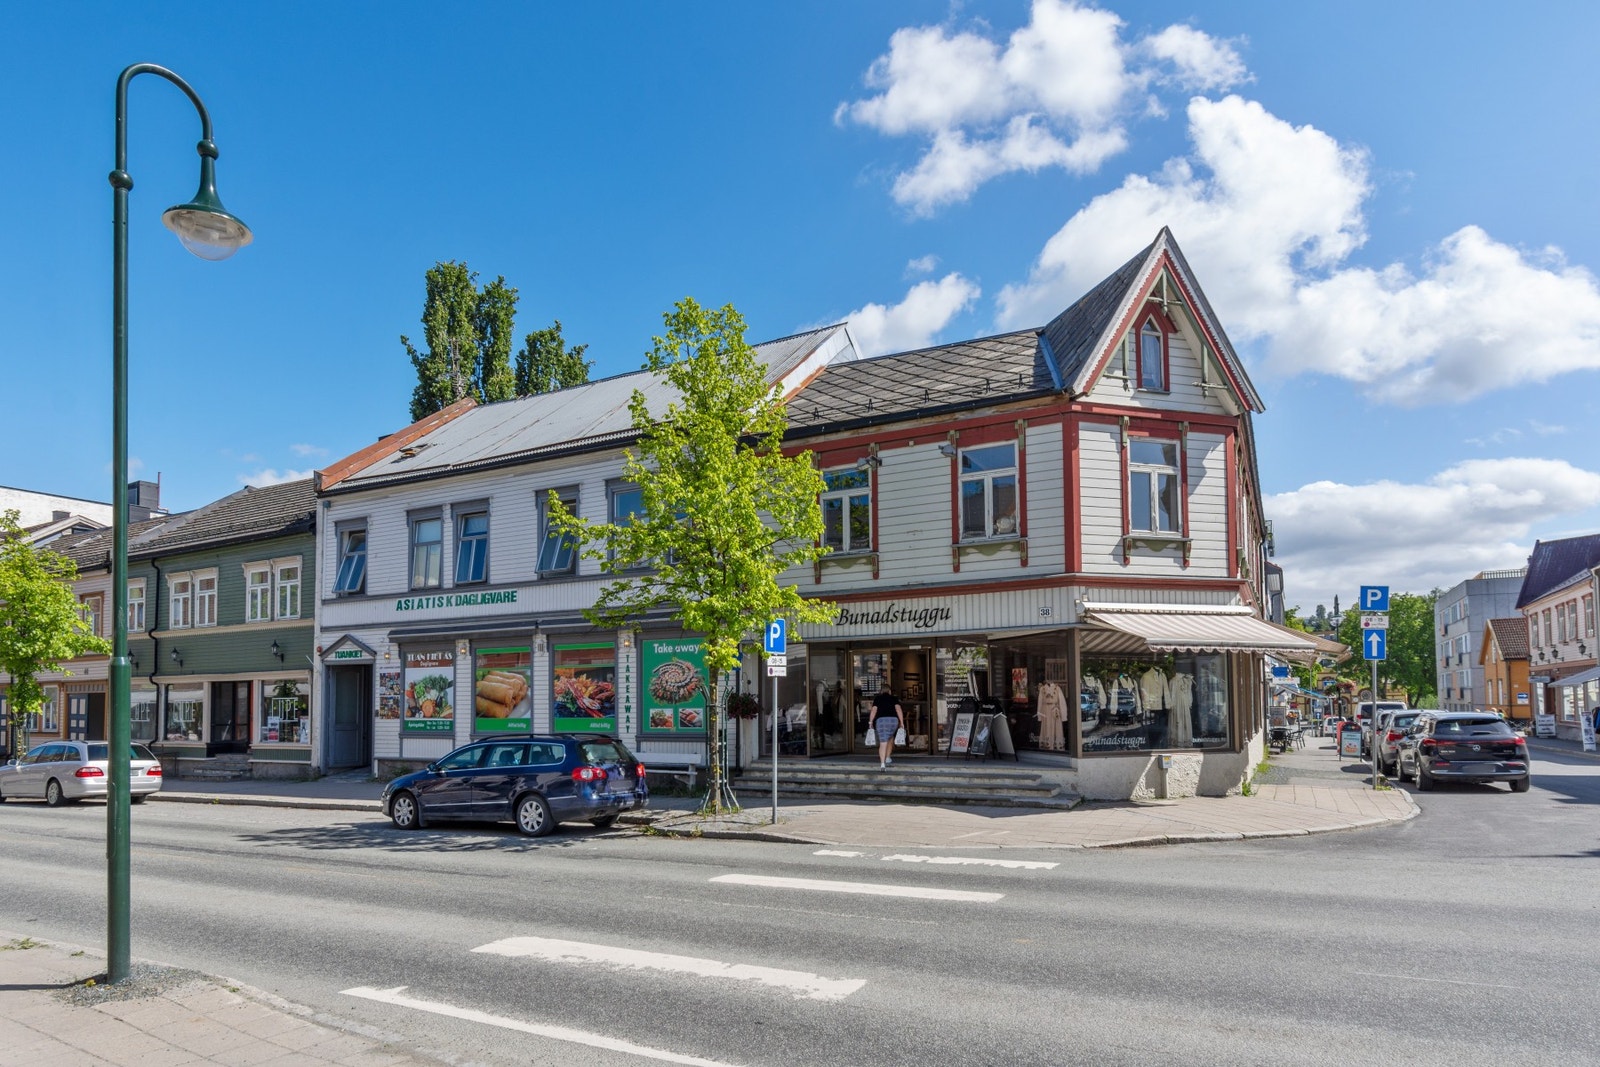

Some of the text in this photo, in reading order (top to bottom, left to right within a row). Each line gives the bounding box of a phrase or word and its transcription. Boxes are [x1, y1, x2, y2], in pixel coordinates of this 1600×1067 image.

[396, 590, 518, 611] ASIATISK DAGLIGVARE
[1367, 589, 1382, 608] P
[836, 603, 951, 628] Bunadstuggu
[1040, 608, 1050, 616] 38
[770, 623, 781, 648] P
[653, 643, 700, 654] Take away
[1087, 733, 1146, 748] Bunadstuggu
